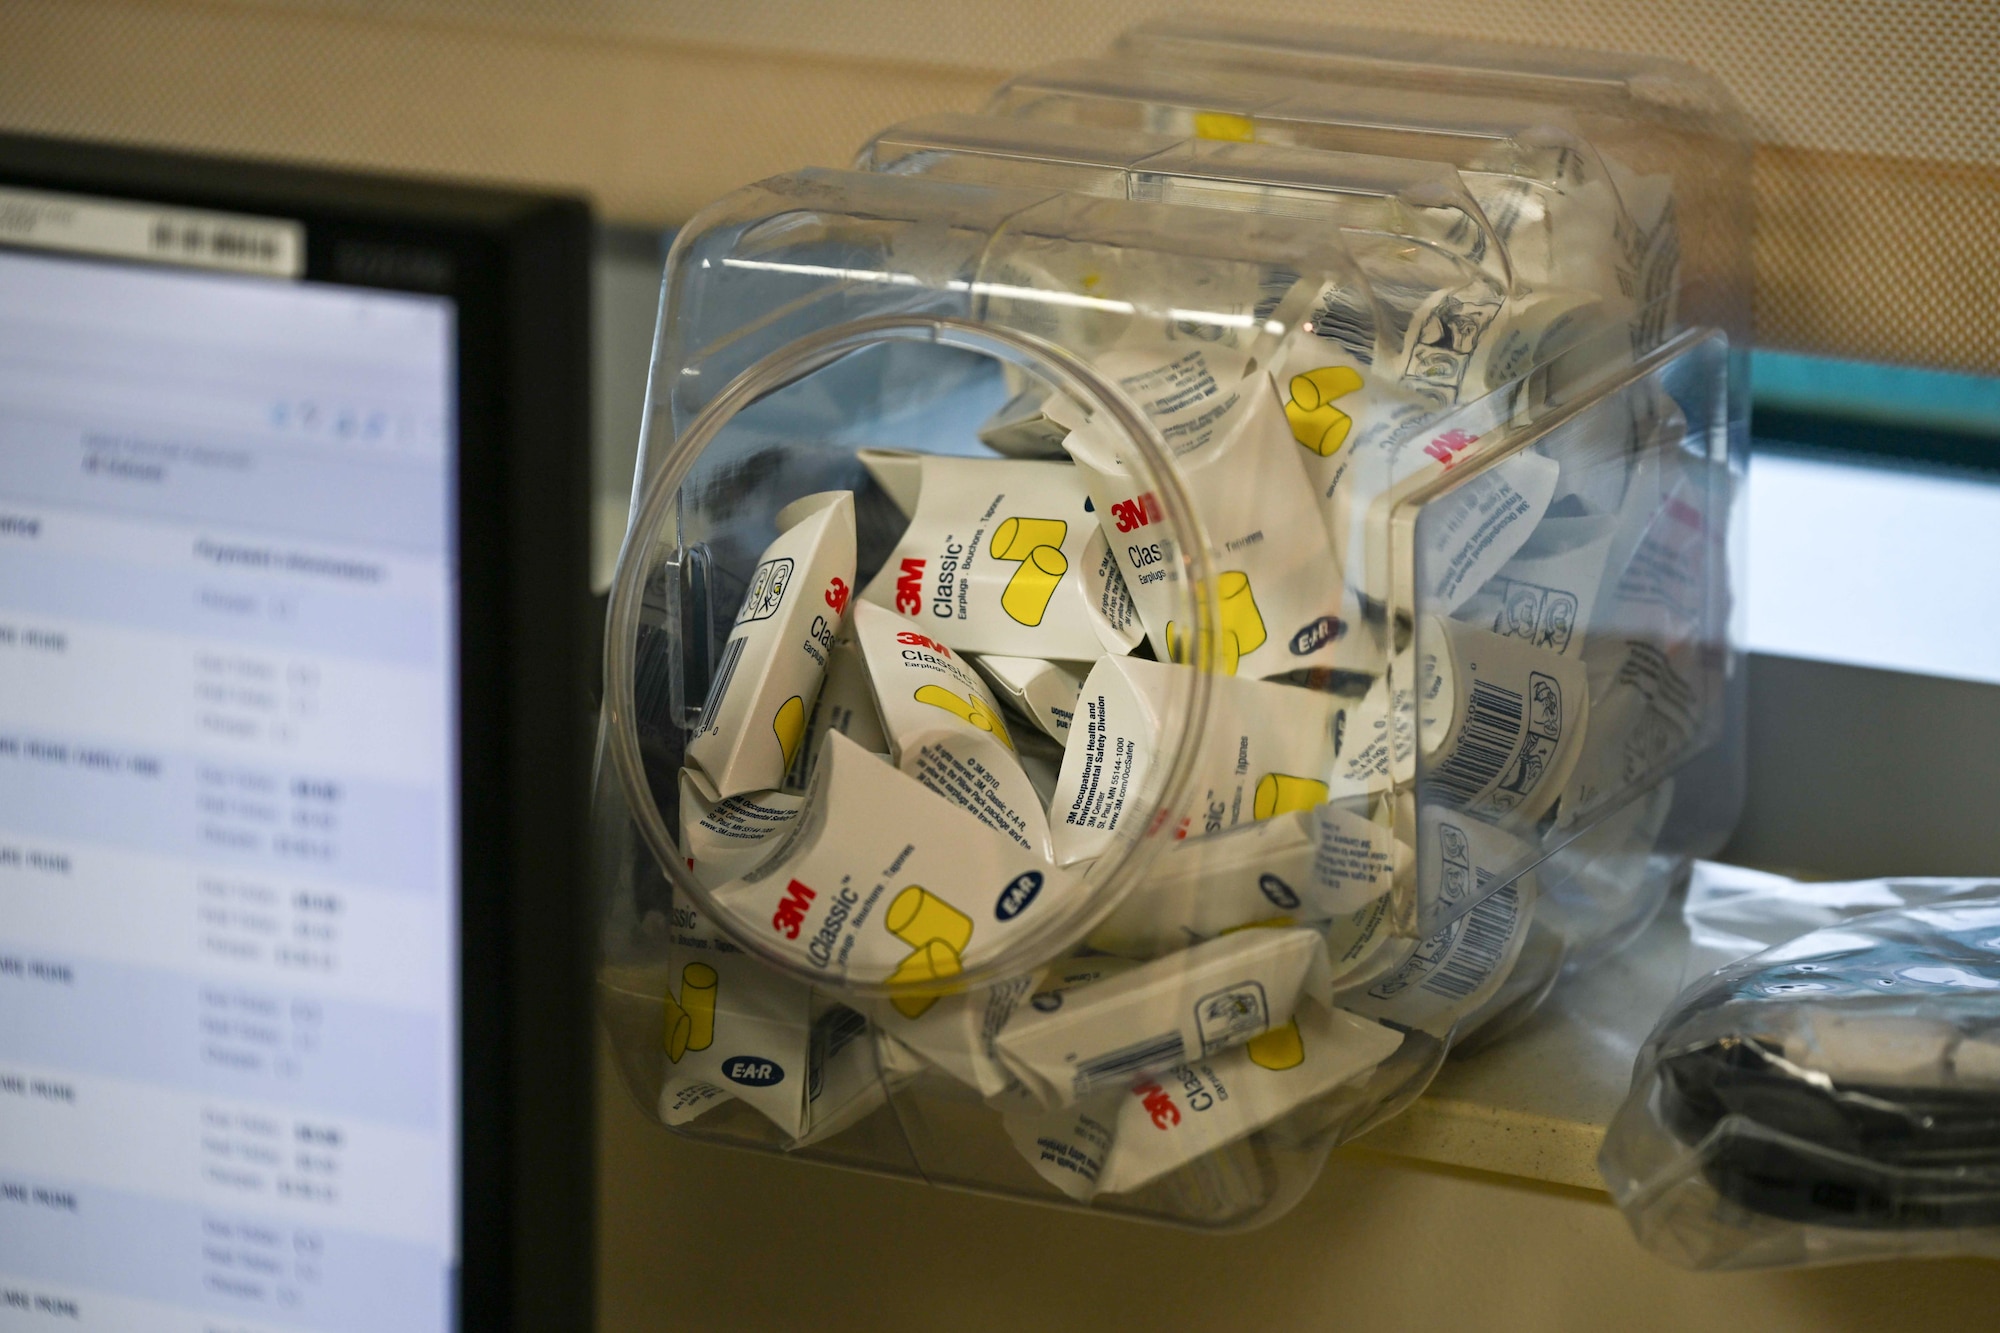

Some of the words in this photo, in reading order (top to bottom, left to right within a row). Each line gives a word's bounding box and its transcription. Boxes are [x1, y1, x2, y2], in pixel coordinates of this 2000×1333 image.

[961, 528, 984, 570] Bouchons
[1128, 544, 1162, 568] Clas
[895, 557, 927, 617] 3M
[1138, 569, 1166, 584] Earplugs
[958, 578, 968, 620] Earplugs
[896, 631, 951, 660] 3M
[905, 661, 945, 673] Earplugs
[1051, 707, 1074, 721] ivision
[1087, 702, 1096, 720] and
[1098, 695, 1106, 731] Division
[1087, 724, 1096, 751] Health
[1095, 733, 1107, 763] Safety
[1111, 737, 1125, 786] 55144-1000
[973, 763, 985, 775] 3M
[982, 771, 1000, 790] 2010.
[1072, 753, 1093, 809] Occupational
[743, 800, 786, 814] Occupational
[944, 783, 969, 806] earplugs
[967, 803, 979, 815] are
[955, 775, 973, 794] Pillow
[971, 790, 986, 807] Pack
[984, 805, 1010, 830] package
[1008, 828, 1022, 842] and
[974, 778, 986, 793] 3M,
[985, 789, 1007, 813] Classic,
[1006, 809, 1026, 832] E-A-R,
[1076, 765, 1102, 826] Environmental
[1107, 787, 1117, 801] MN
[714, 806, 727, 815] 3M
[725, 811, 746, 824] Center
[722, 799, 773, 820] Environmental
[1066, 812, 1077, 824] 3M
[1087, 815, 1097, 827] 3M
[1092, 791, 1106, 815] Center
[1101, 801, 1113, 820] Paul,
[773, 878, 817, 941] 3M
